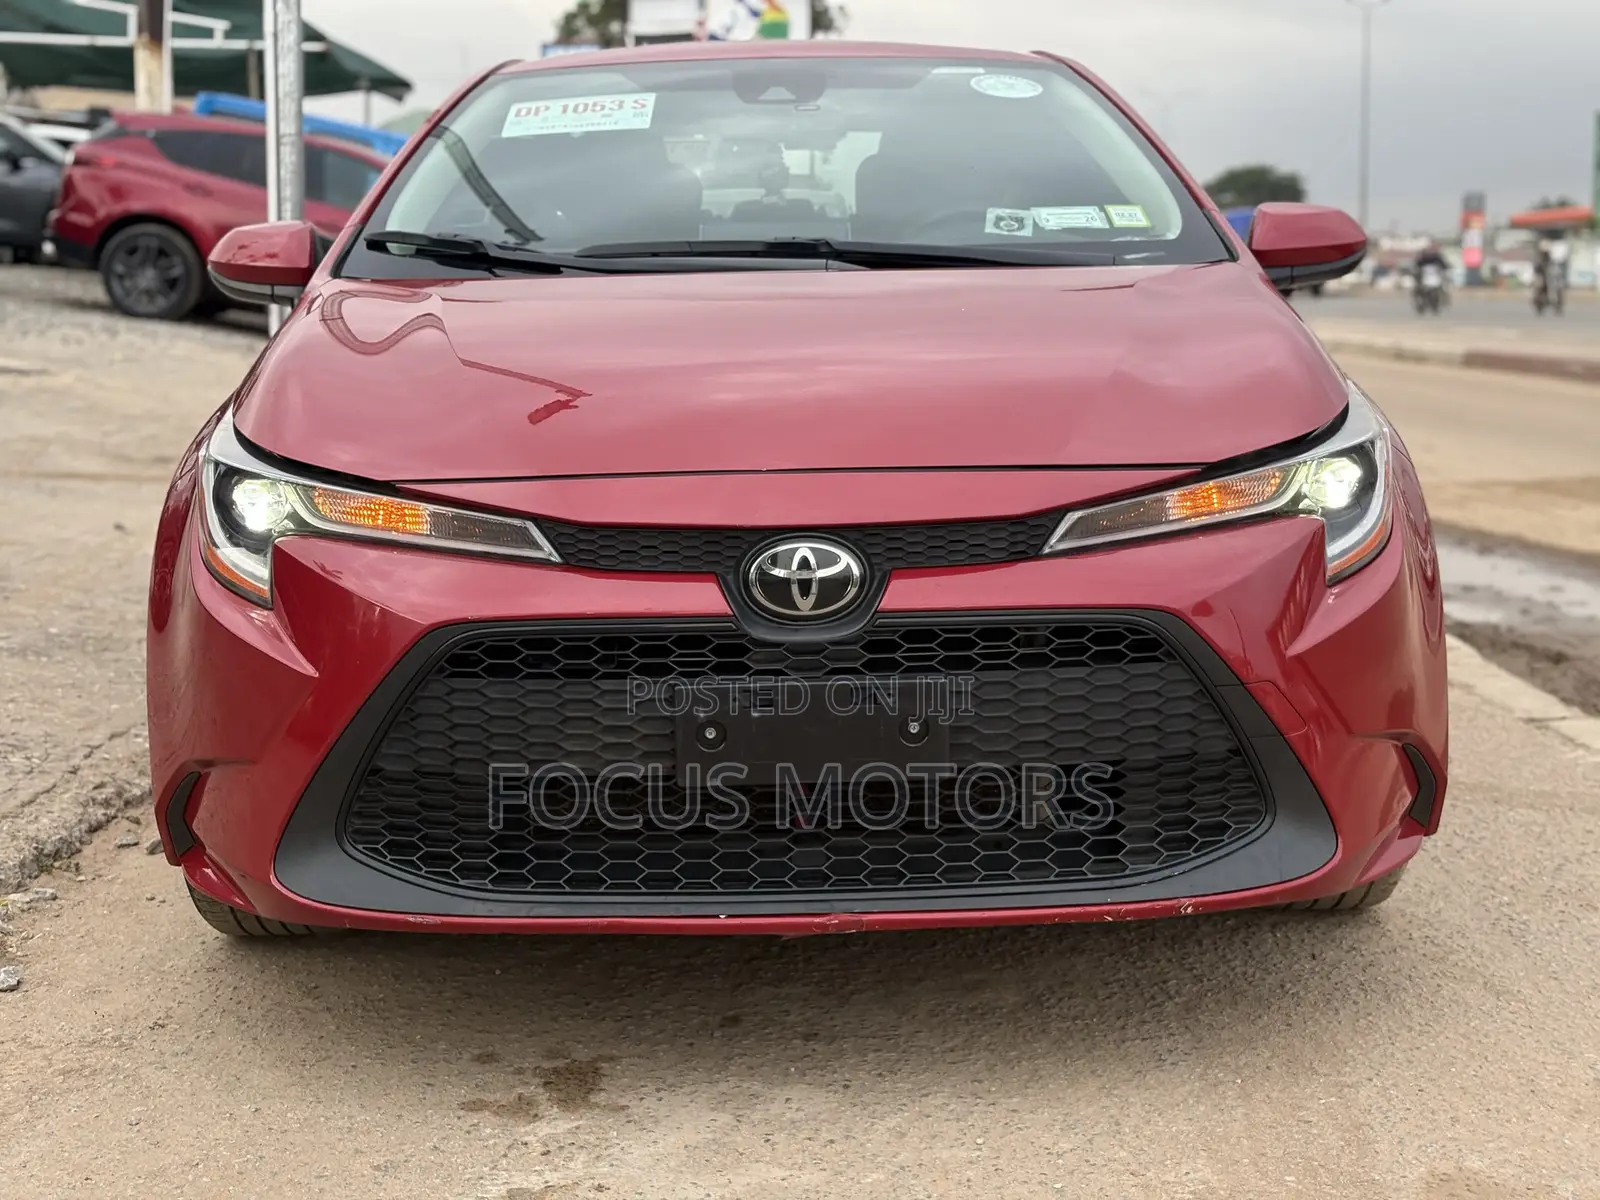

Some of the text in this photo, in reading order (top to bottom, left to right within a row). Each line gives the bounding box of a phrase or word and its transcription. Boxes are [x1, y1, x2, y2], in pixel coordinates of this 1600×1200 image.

[514, 104, 550, 118] DP
[560, 100, 624, 115] 1053
[631, 98, 648, 110] S
